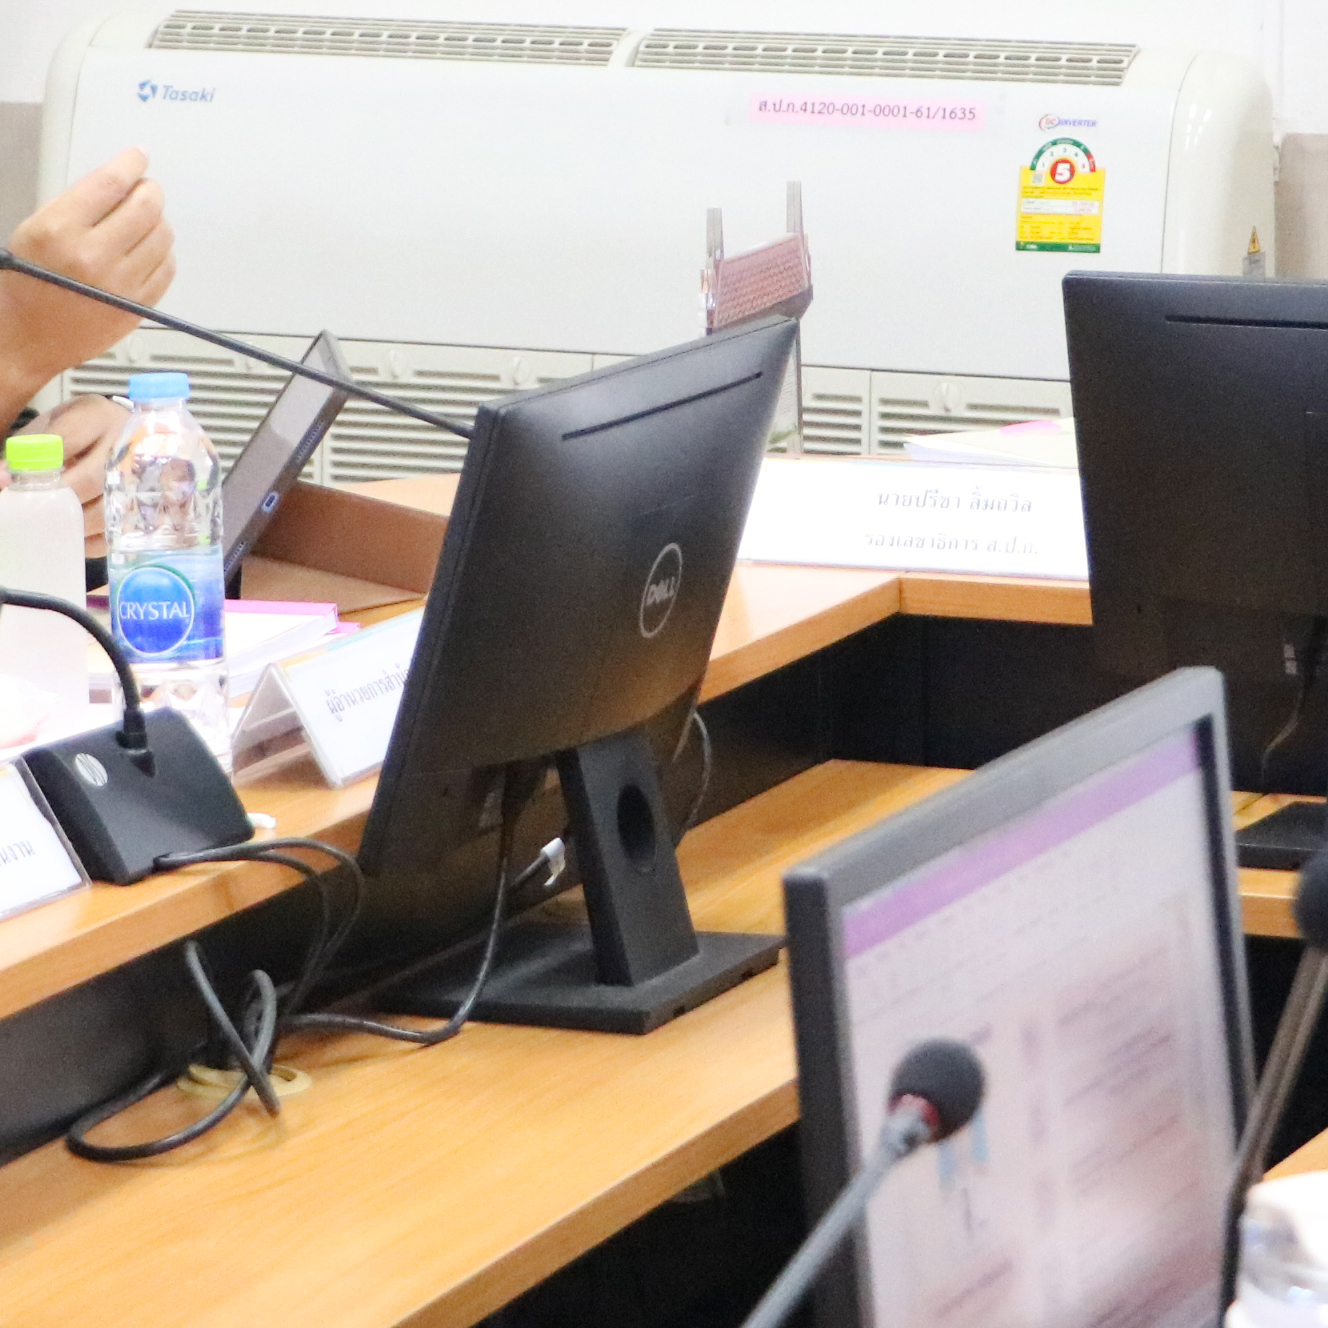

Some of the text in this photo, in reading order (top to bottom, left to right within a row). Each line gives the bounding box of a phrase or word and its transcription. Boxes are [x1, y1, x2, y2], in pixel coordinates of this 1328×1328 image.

[163, 85, 216, 102] Tasaki
[758, 99, 977, 120] ส.ป.ก.4120-001-0001-61/1635
[1054, 162, 1072, 181] 5
[120, 601, 190, 620] CRYSTAL
